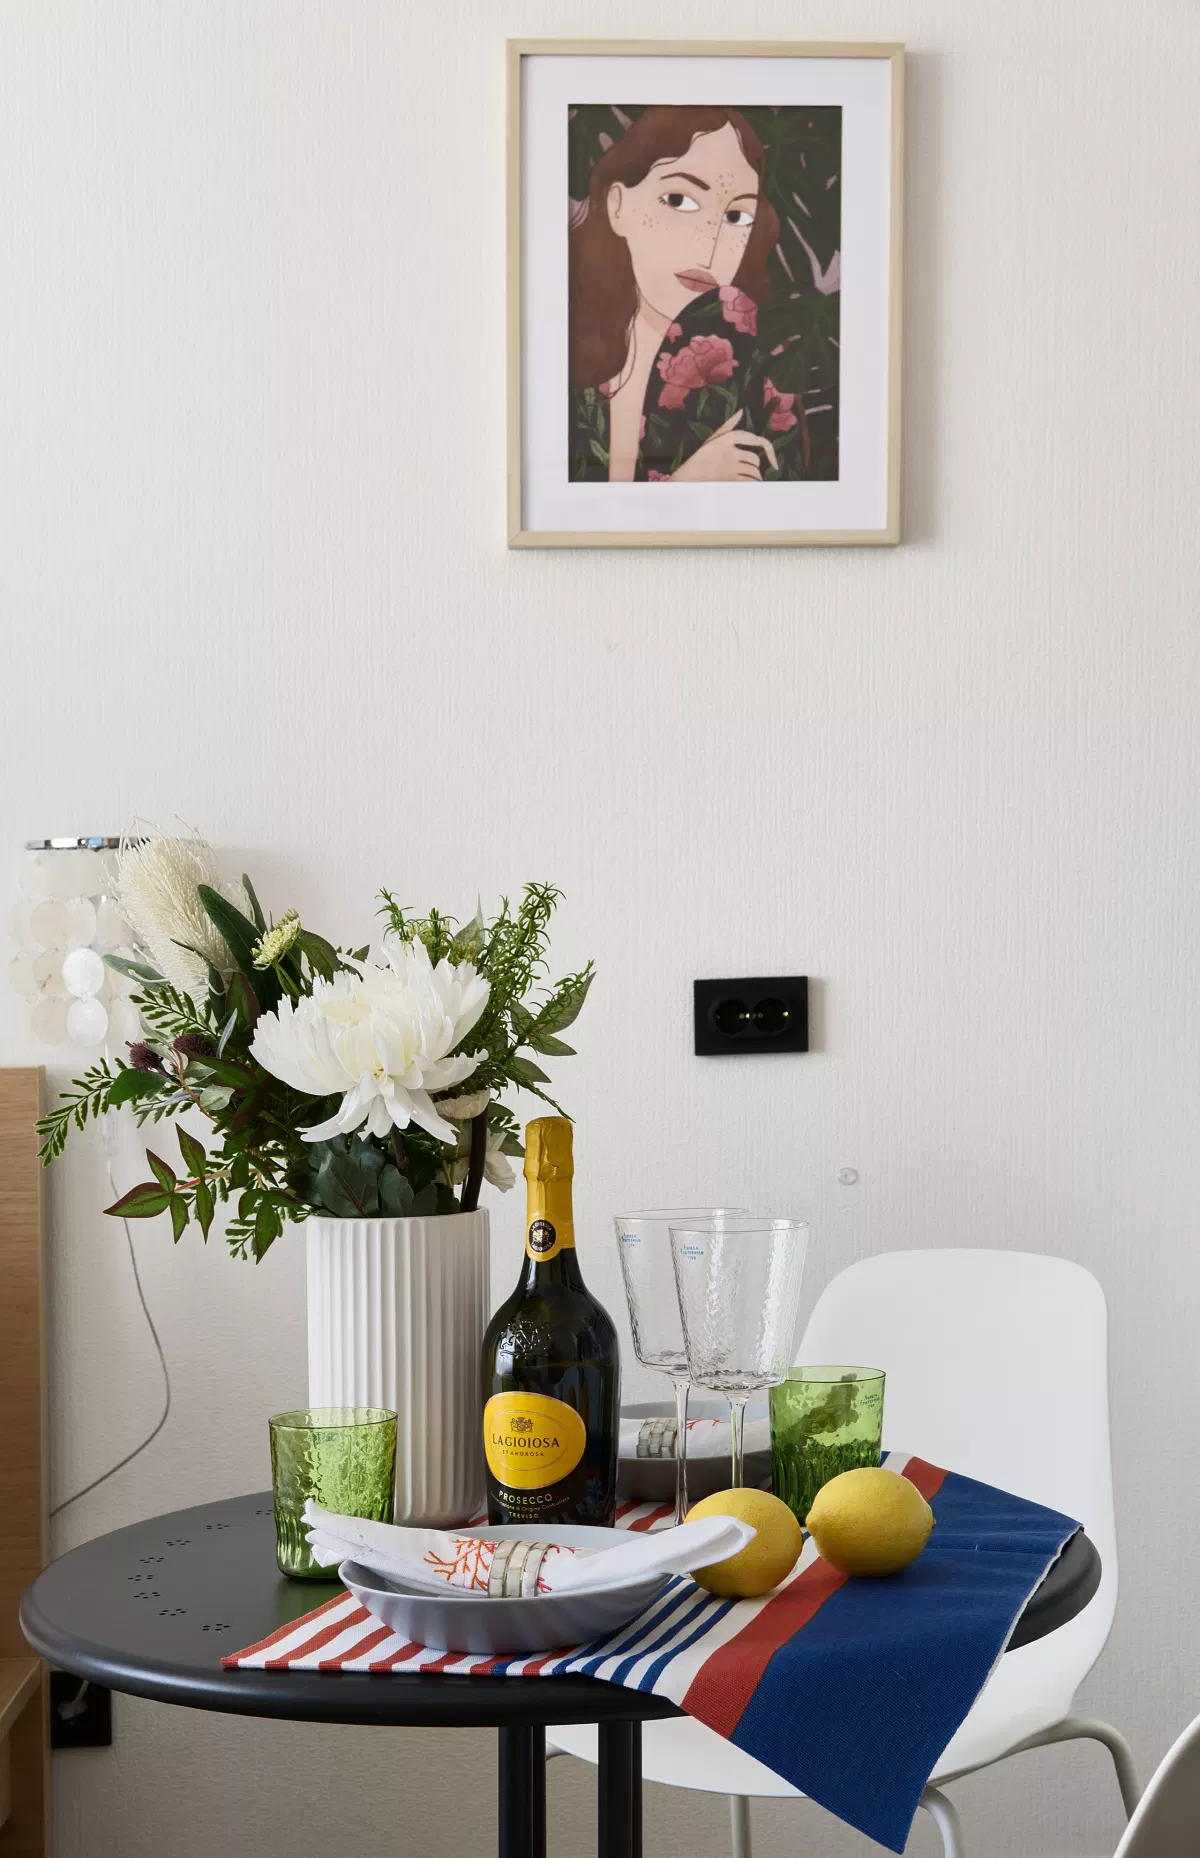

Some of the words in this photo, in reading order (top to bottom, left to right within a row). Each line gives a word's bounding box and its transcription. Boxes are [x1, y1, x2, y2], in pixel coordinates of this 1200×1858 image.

[492, 1434, 559, 1448] LAGIOIOSA
[499, 1490, 552, 1504] PROSECCO
[508, 1511, 539, 1519] TREVISO
